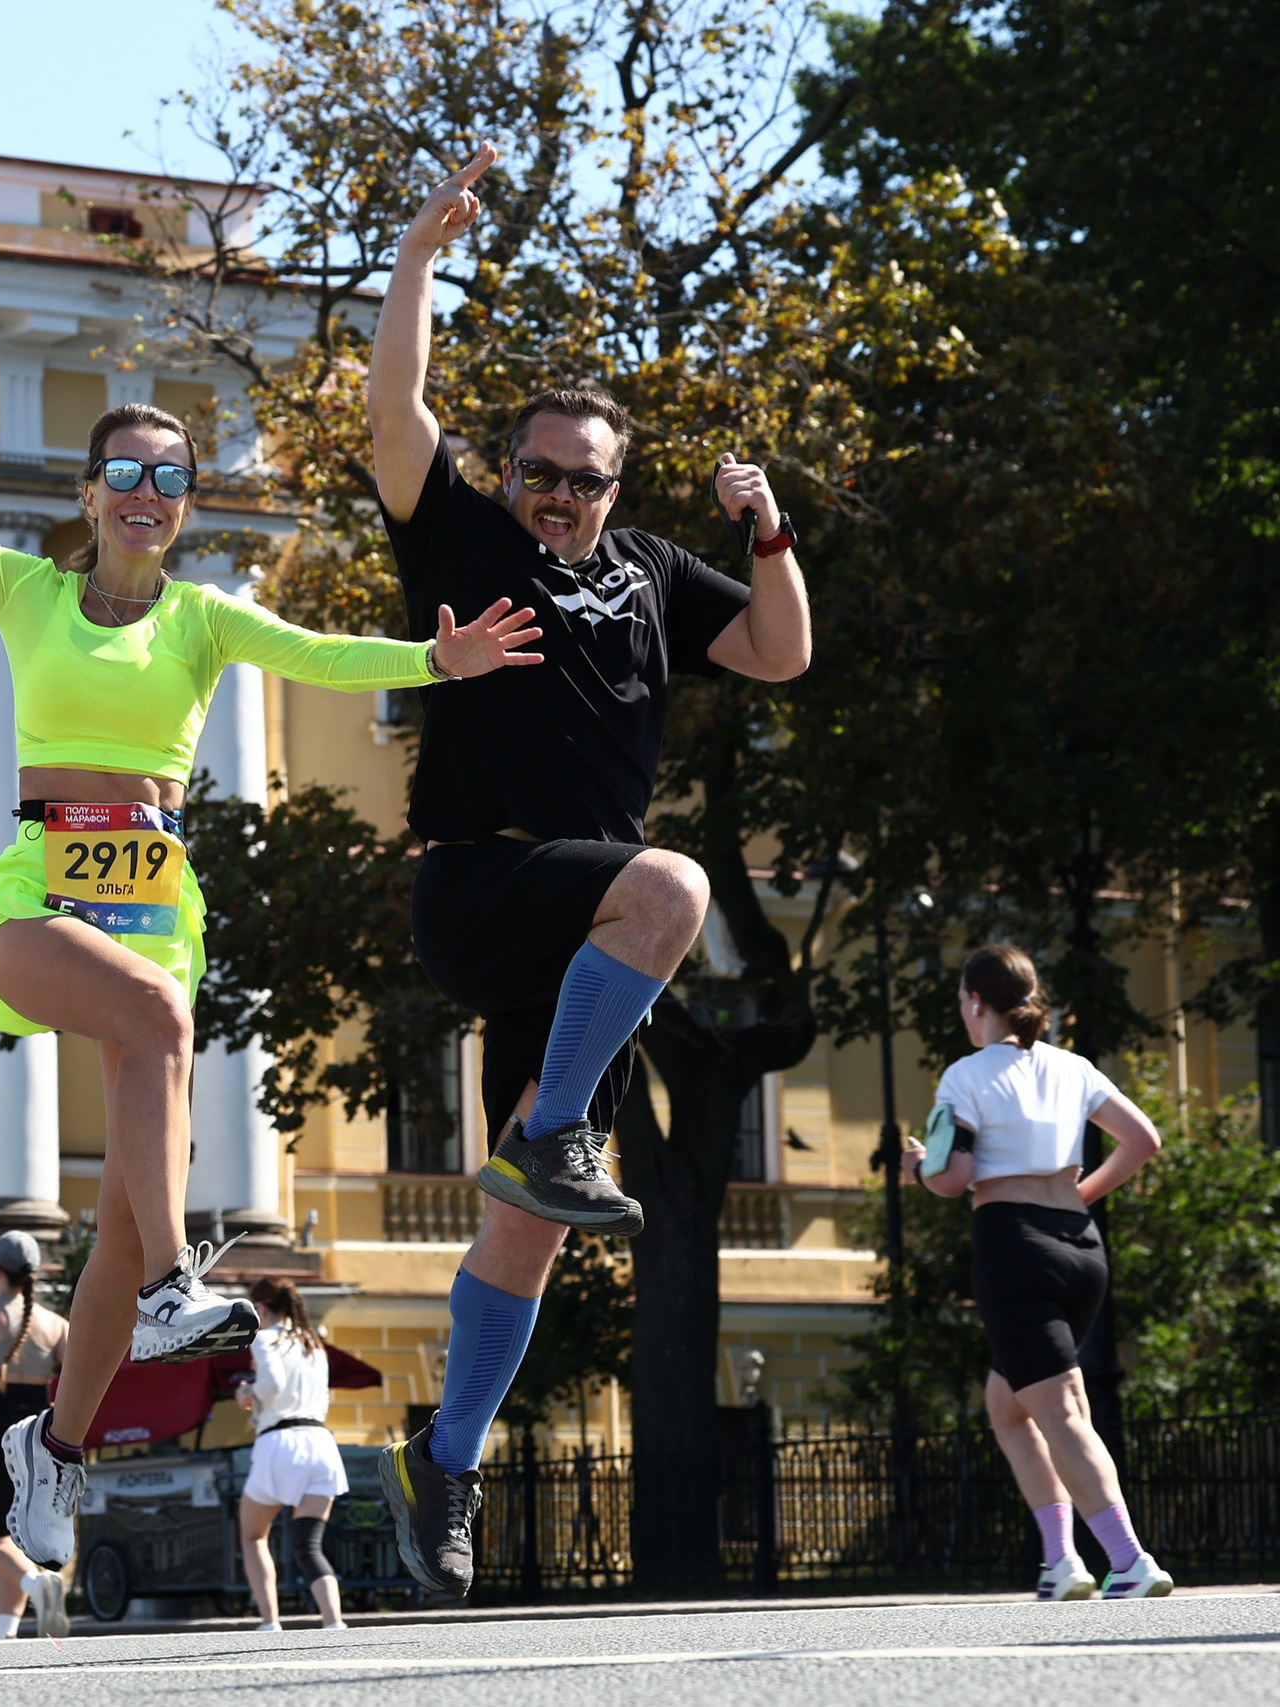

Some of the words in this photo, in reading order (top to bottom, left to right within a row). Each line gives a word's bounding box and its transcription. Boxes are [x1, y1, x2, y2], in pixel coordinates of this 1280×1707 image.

[65, 806, 90, 815] ПОЛУ
[65, 814, 110, 823] МАРАФОН
[64, 840, 168, 881] 2919
[96, 883, 134, 896] ОЛЬГА
